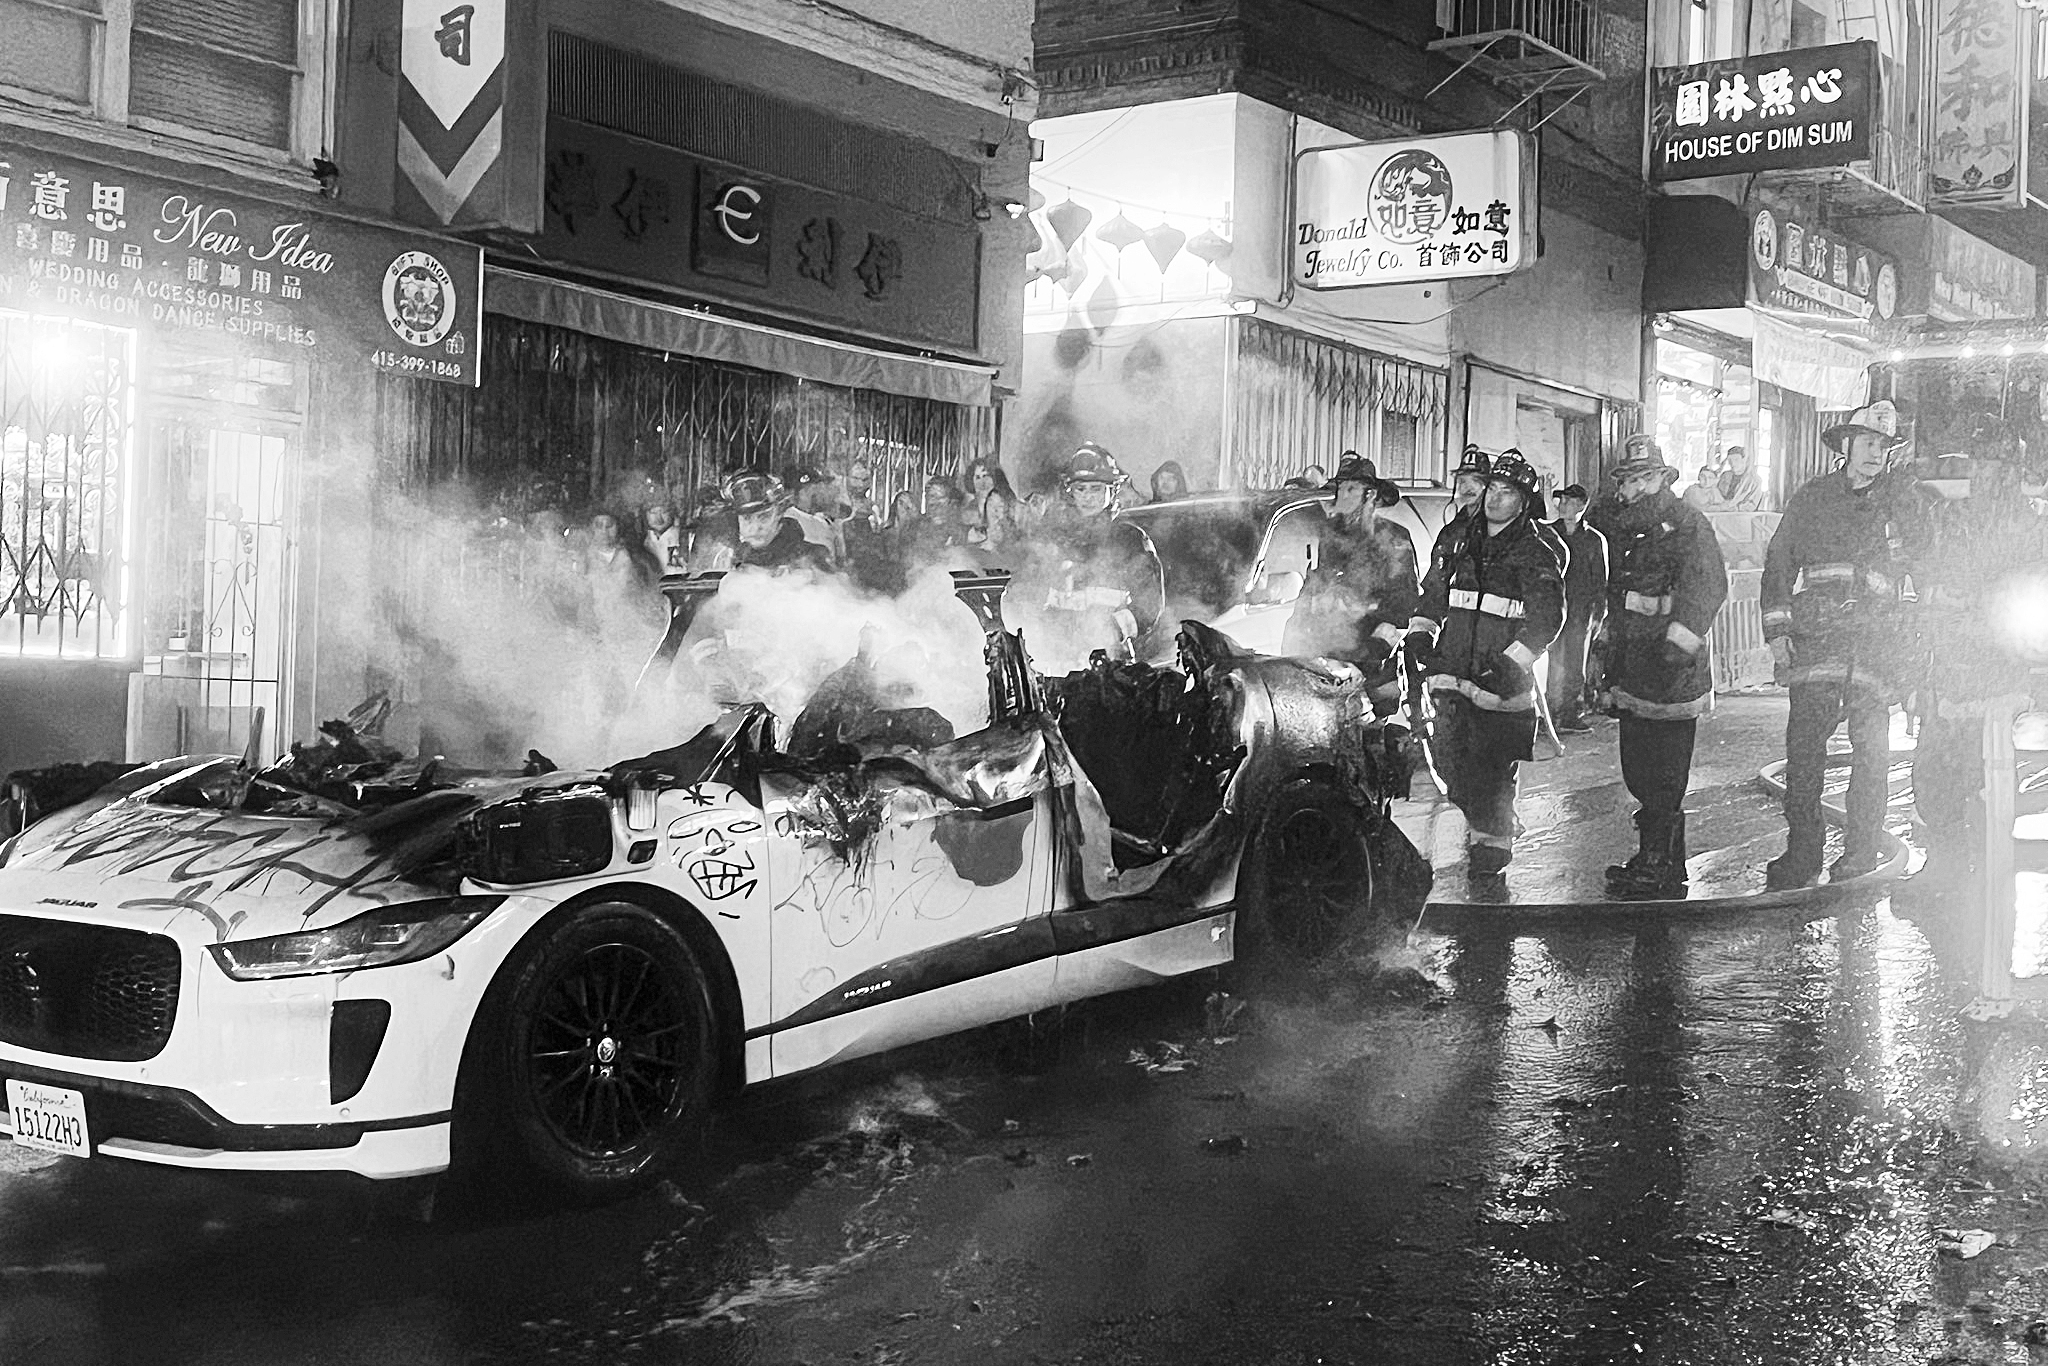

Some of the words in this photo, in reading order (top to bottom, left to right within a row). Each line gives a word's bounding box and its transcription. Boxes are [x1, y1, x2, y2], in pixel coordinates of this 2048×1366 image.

[434, 4, 474, 66] 司
[1665, 134, 1733, 163] HOUSE
[1736, 131, 1763, 154] OF
[1767, 125, 1803, 151] DIM
[1808, 120, 1853, 146] SUM
[0, 161, 127, 232] 意思
[153, 195, 242, 256] New
[249, 222, 335, 274] Idea
[1299, 217, 1368, 246] Donald
[1451, 199, 1511, 237] 如意
[423, 256, 450, 285] SHOP
[1304, 247, 1371, 278] Jewelry
[1377, 250, 1403, 269] Co.
[1416, 239, 1508, 268] 首飾公司
[28, 257, 119, 290] WEDDING
[132, 276, 263, 316] ACCESSORIES
[56, 286, 140, 318] DRAGON
[152, 303, 215, 328] DANCE
[224, 316, 317, 347] SUPPLIES
[371, 350, 461, 378] 415-399-1868
[15, 1106, 82, 1147] 15122H3
